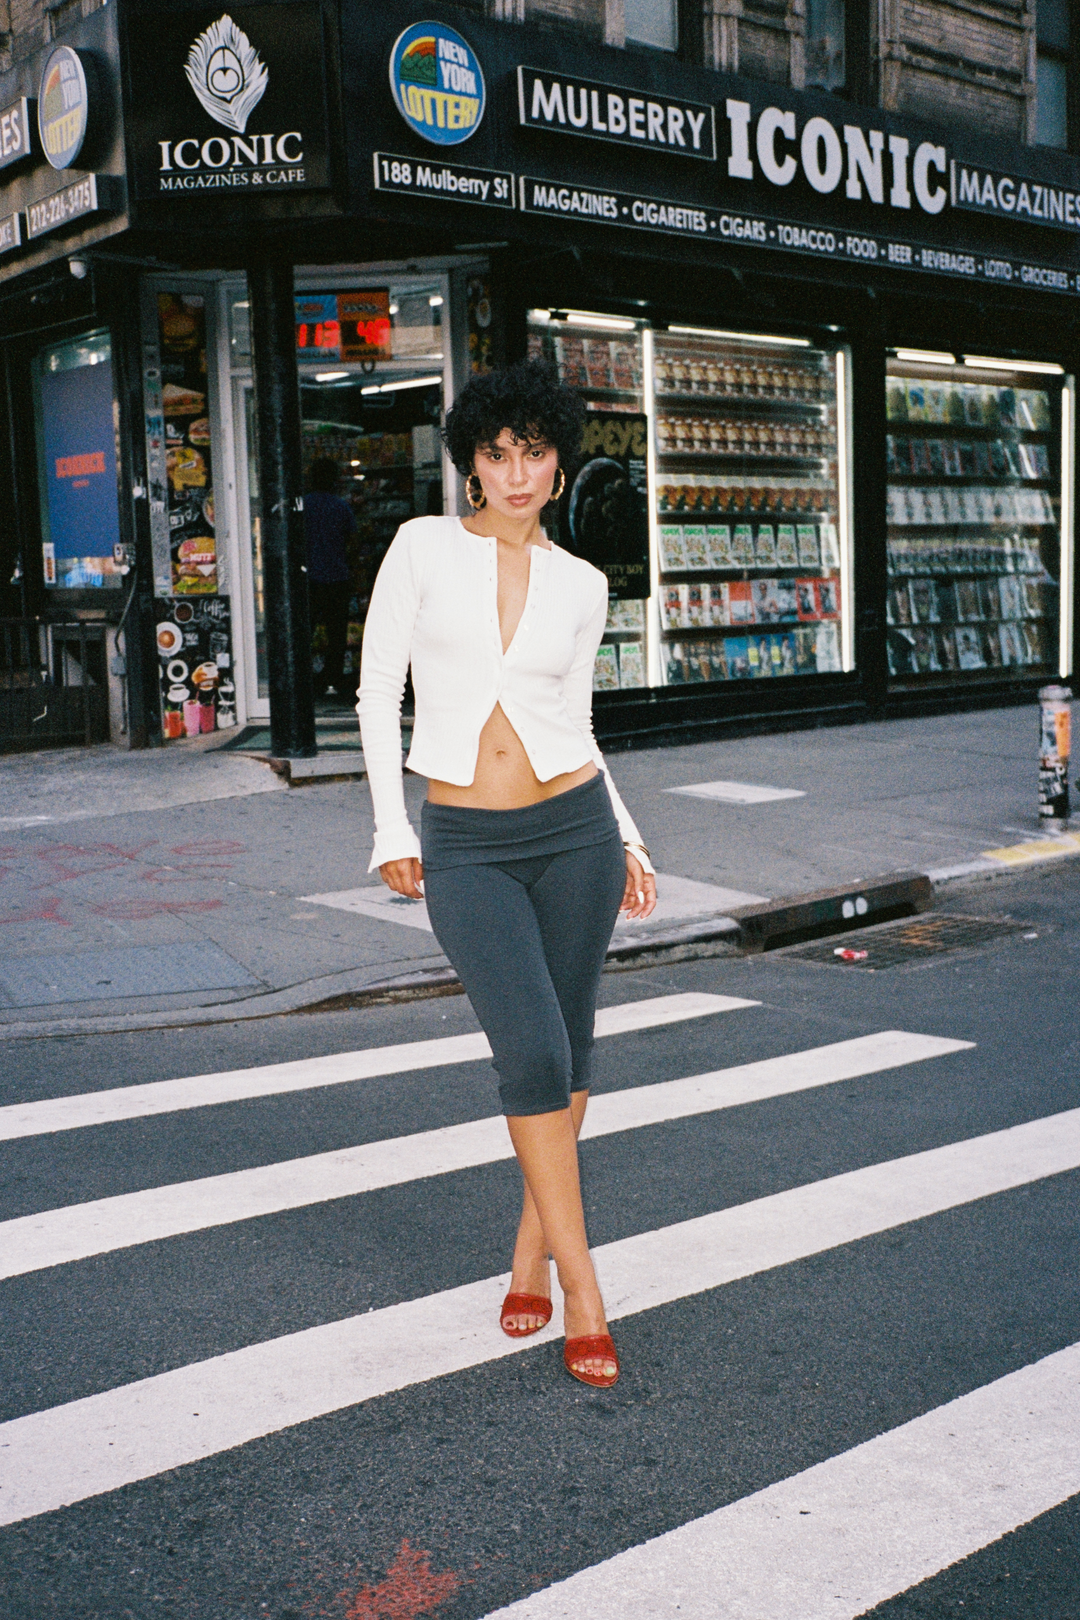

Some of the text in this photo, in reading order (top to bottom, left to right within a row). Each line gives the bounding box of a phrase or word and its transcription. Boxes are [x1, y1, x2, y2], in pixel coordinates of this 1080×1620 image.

[437, 38, 469, 67] NEW
[440, 60, 477, 95] YORK
[400, 83, 480, 130] LOTTERY
[531, 78, 706, 149] MULBERRY
[0, 109, 21, 158] ES
[158, 131, 304, 171] ICONIC
[726, 98, 947, 215] ICONIC
[160, 169, 306, 190] MAGAZINES & CAFE
[382, 160, 509, 200] 188 Mulberry St
[30, 181, 91, 232] 212-226-3475
[533, 184, 618, 219] MAGAZINES
[632, 200, 707, 232] CIGARETTES
[719, 214, 767, 242] CIGARS
[777, 224, 836, 253] TOBACCO
[846, 236, 878, 259] FOOD
[888, 243, 912, 264] BEER
[921, 248, 976, 275] BEVERAGES
[1020, 265, 1068, 290] GROCERIES
[580, 419, 646, 456] PEYE
